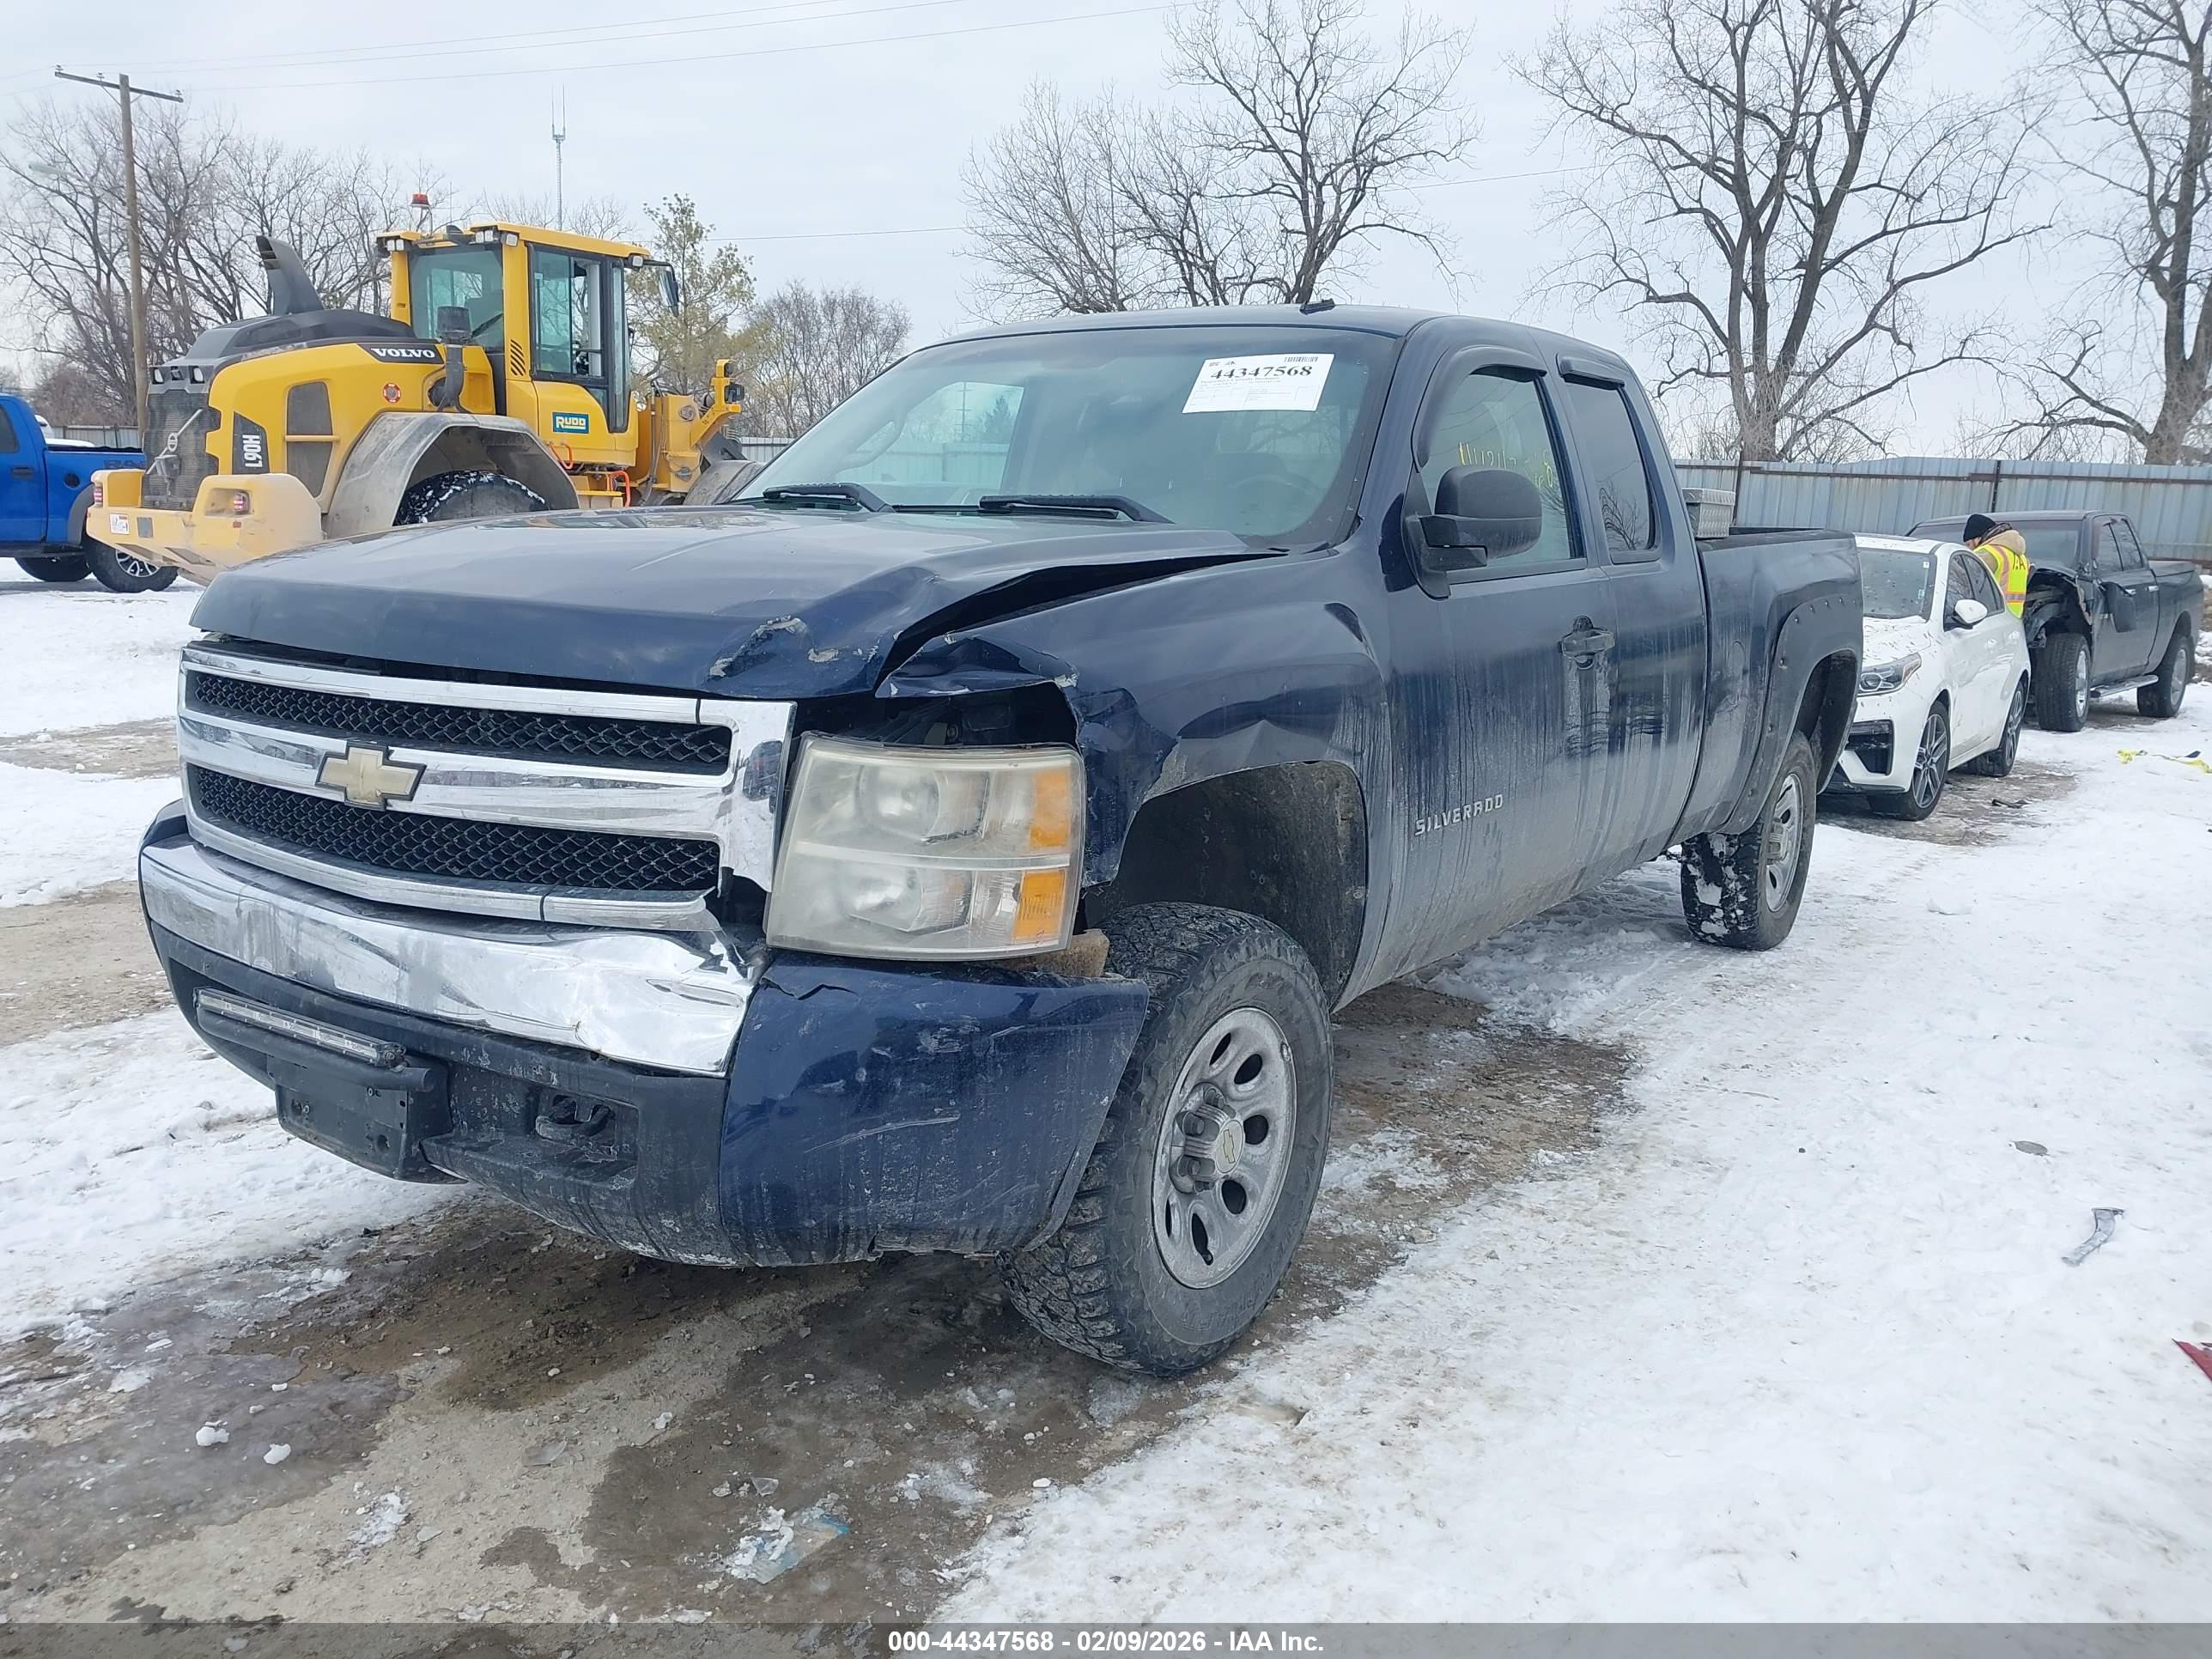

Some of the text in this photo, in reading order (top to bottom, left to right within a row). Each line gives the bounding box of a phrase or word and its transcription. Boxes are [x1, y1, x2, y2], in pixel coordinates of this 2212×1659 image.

[370, 348, 435, 358] VOLVO
[1210, 366, 1313, 379] 44347568
[556, 416, 586, 429] RUDD
[242, 434, 263, 468] L90H
[1414, 793, 1504, 836] SILVERADO
